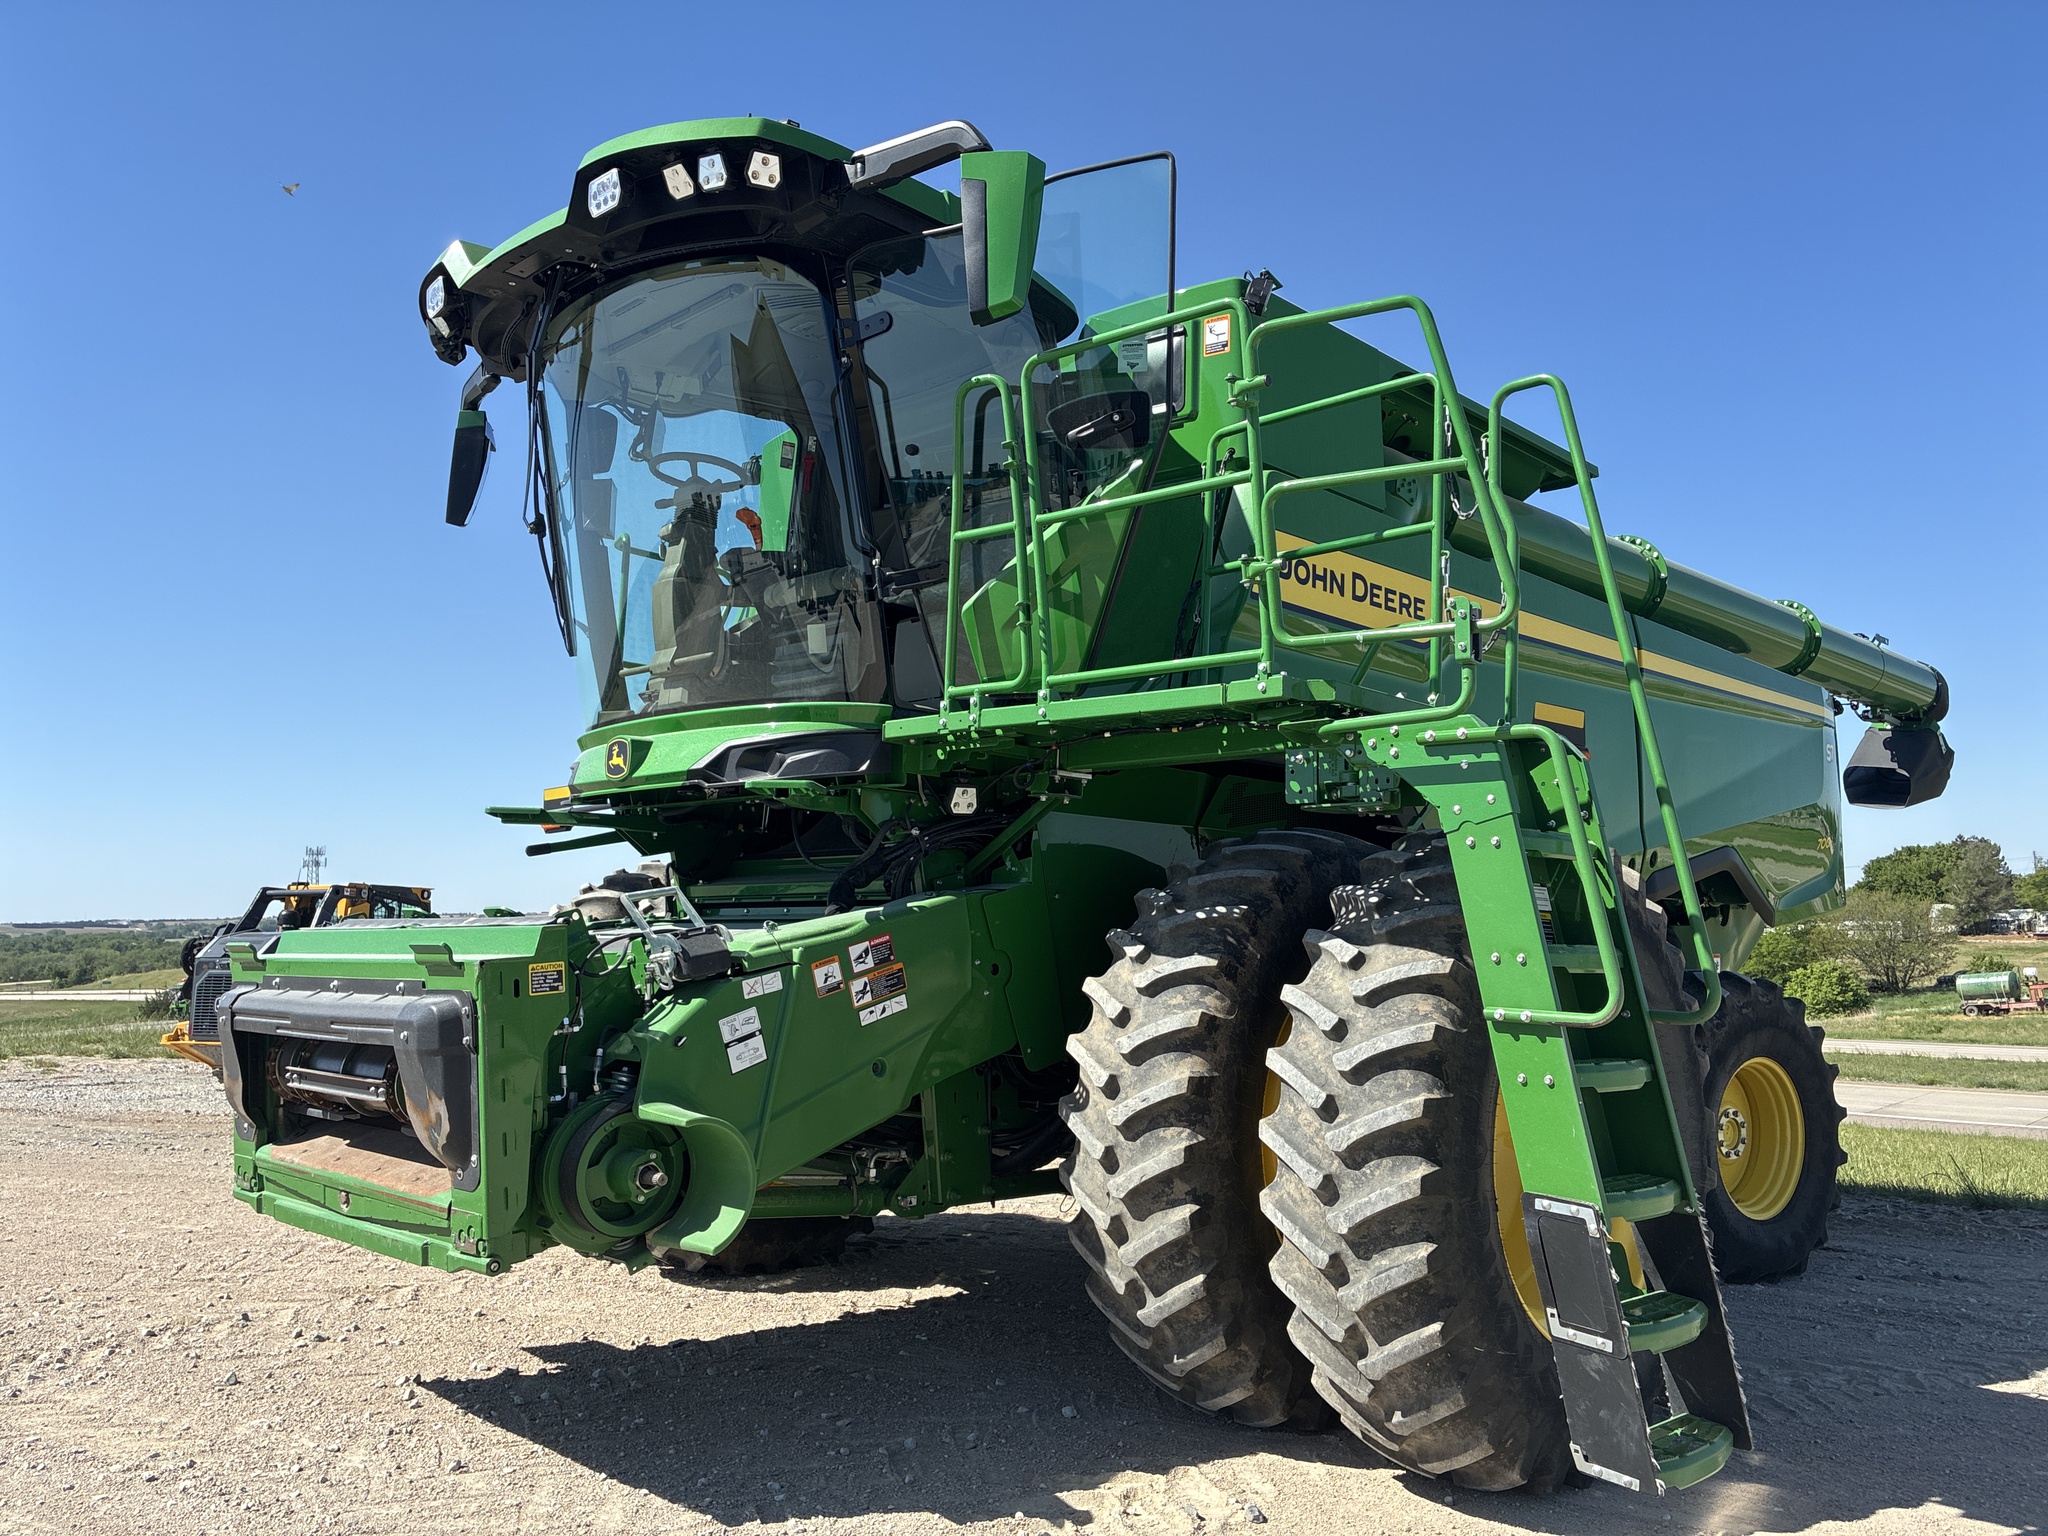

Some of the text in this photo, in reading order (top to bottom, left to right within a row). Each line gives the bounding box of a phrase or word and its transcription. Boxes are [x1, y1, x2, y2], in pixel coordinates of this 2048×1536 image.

[1279, 559, 1426, 620] JOHN DEERE
[874, 935, 890, 945] DANGER
[819, 957, 836, 967] WARNING
[877, 966, 894, 975] WARNING
